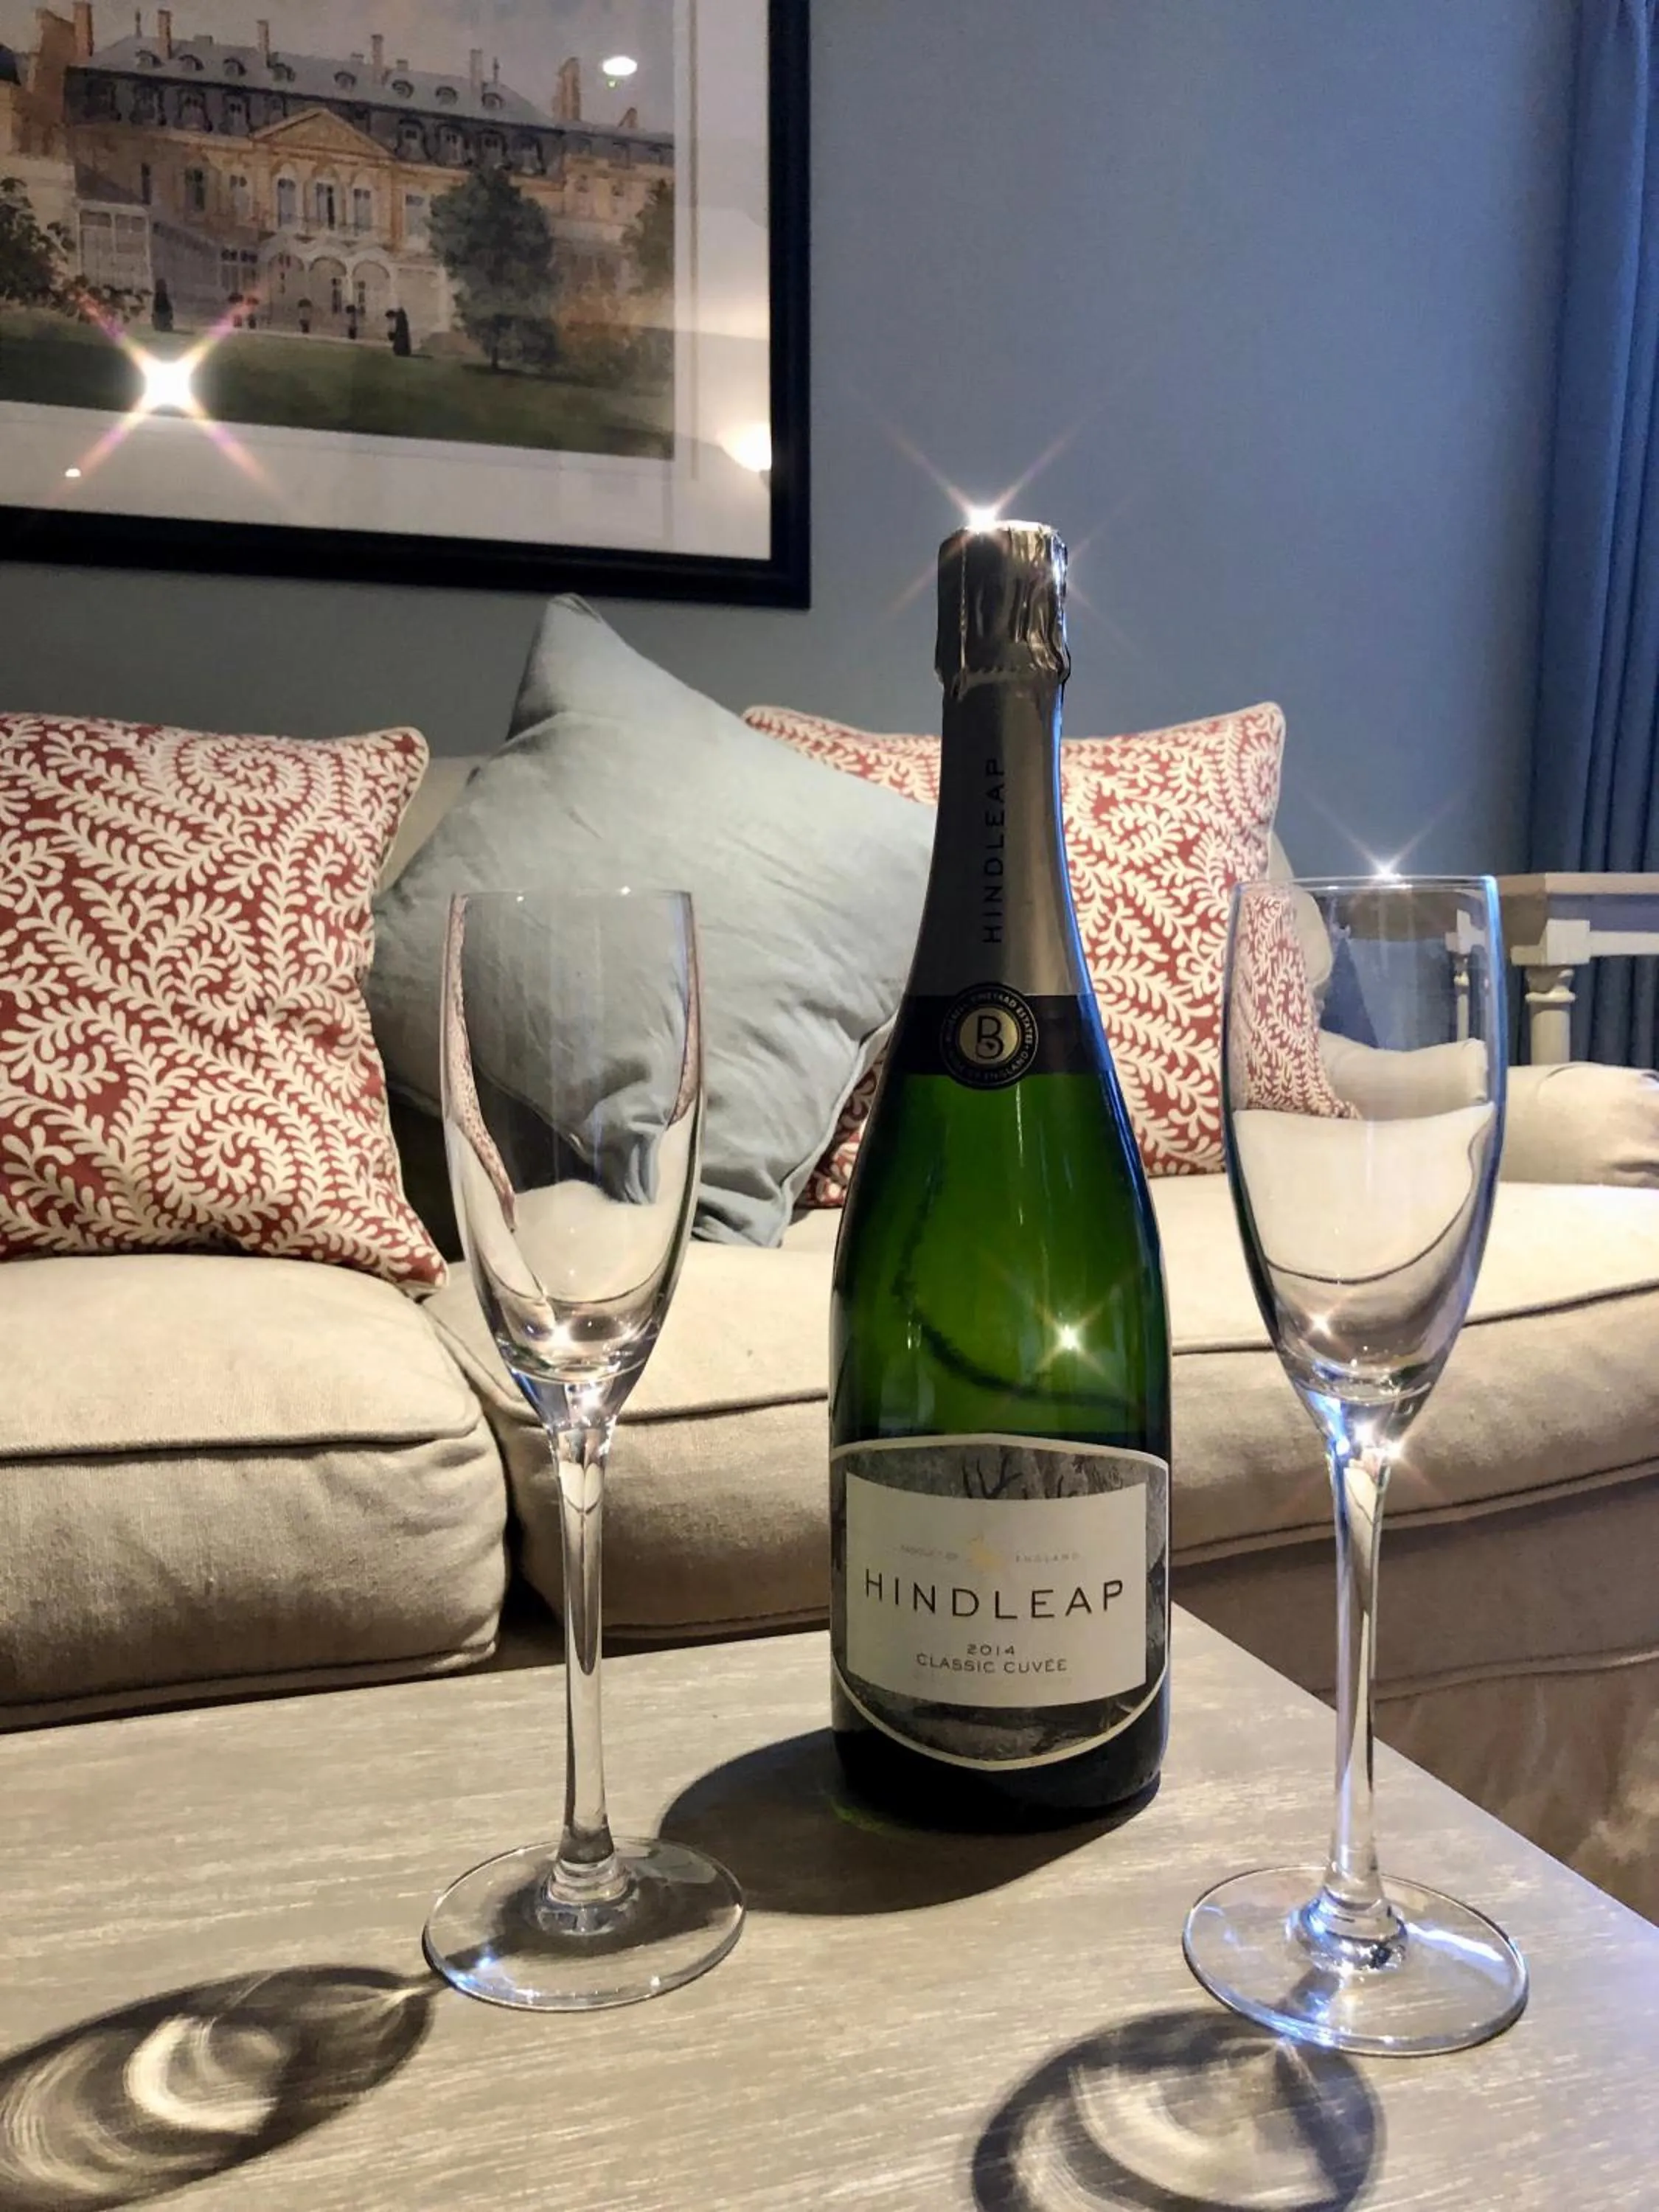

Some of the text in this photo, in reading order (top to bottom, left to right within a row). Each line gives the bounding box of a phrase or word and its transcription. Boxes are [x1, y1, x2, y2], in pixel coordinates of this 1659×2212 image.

[981, 758, 1005, 944] HINDLEAP
[864, 1568, 1124, 1620] HINDLEAP
[916, 1652, 995, 1674] CLASSIC
[966, 1642, 1015, 1657] 2014
